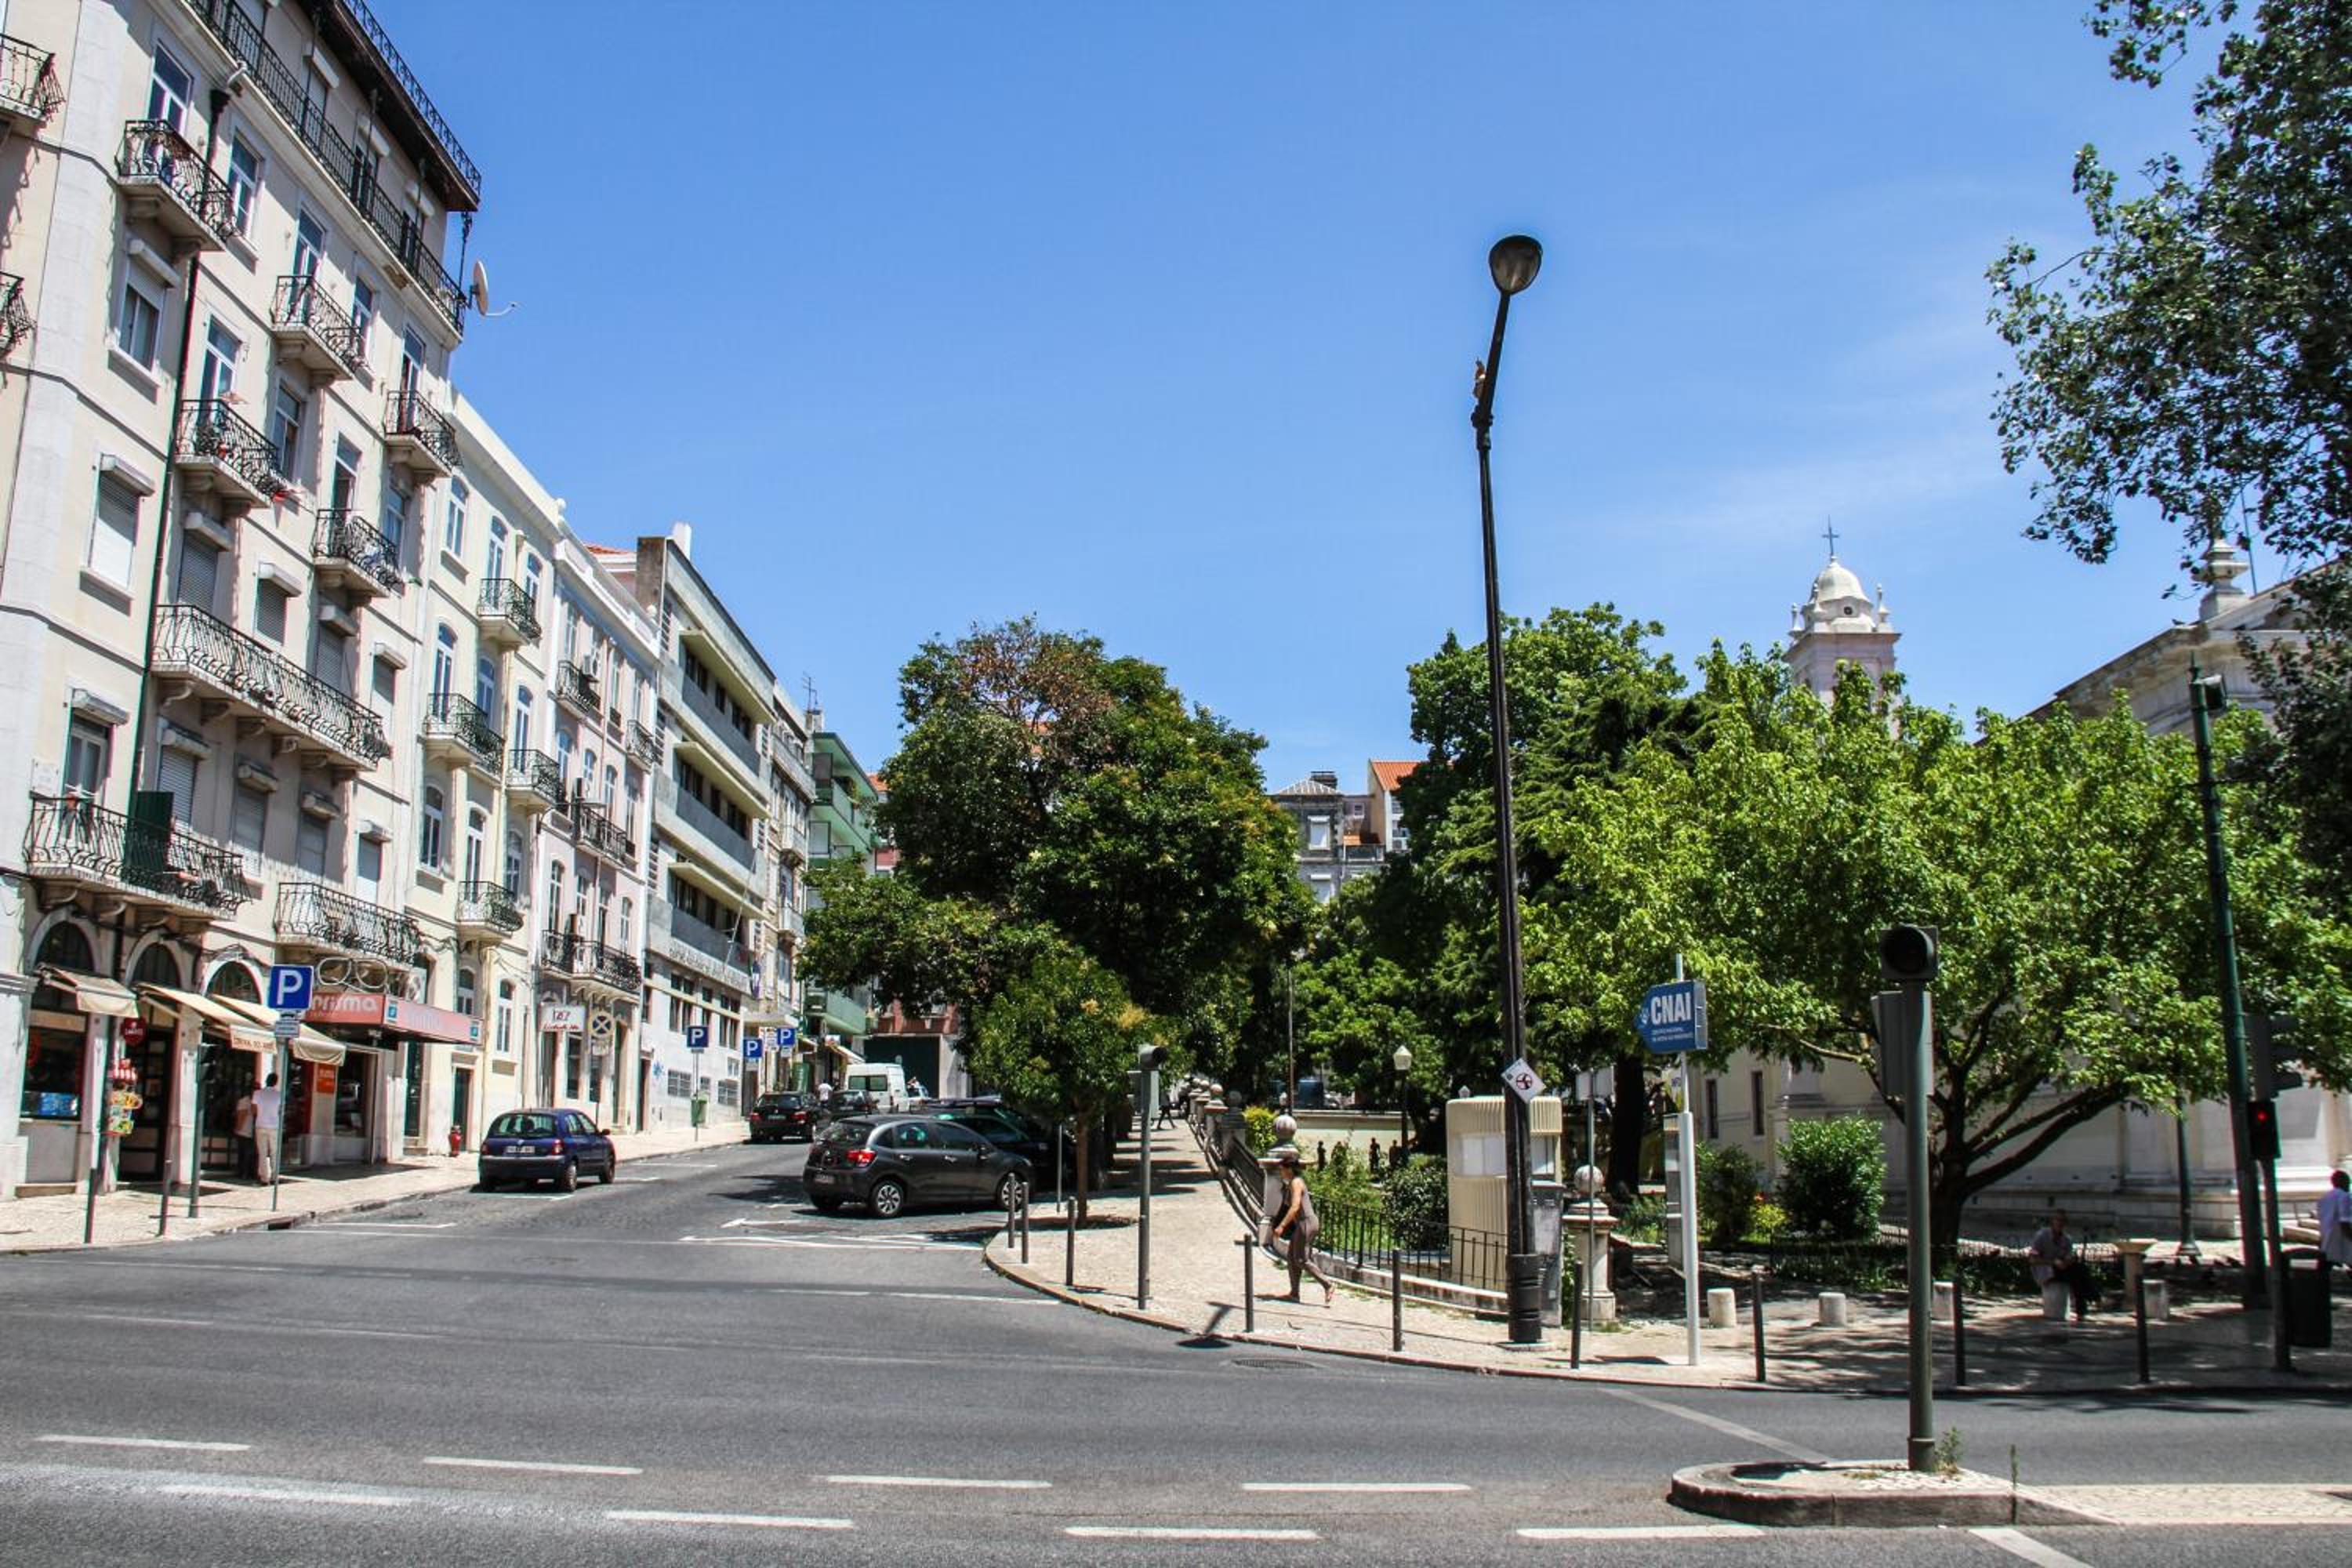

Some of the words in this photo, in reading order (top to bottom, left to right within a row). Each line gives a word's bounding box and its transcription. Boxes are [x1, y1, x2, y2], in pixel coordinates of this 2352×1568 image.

[277, 970, 303, 1005] P
[1650, 993, 1691, 1025] CNAI
[691, 1028, 704, 1044] P
[780, 1028, 792, 1044] P
[746, 1040, 758, 1056] P
